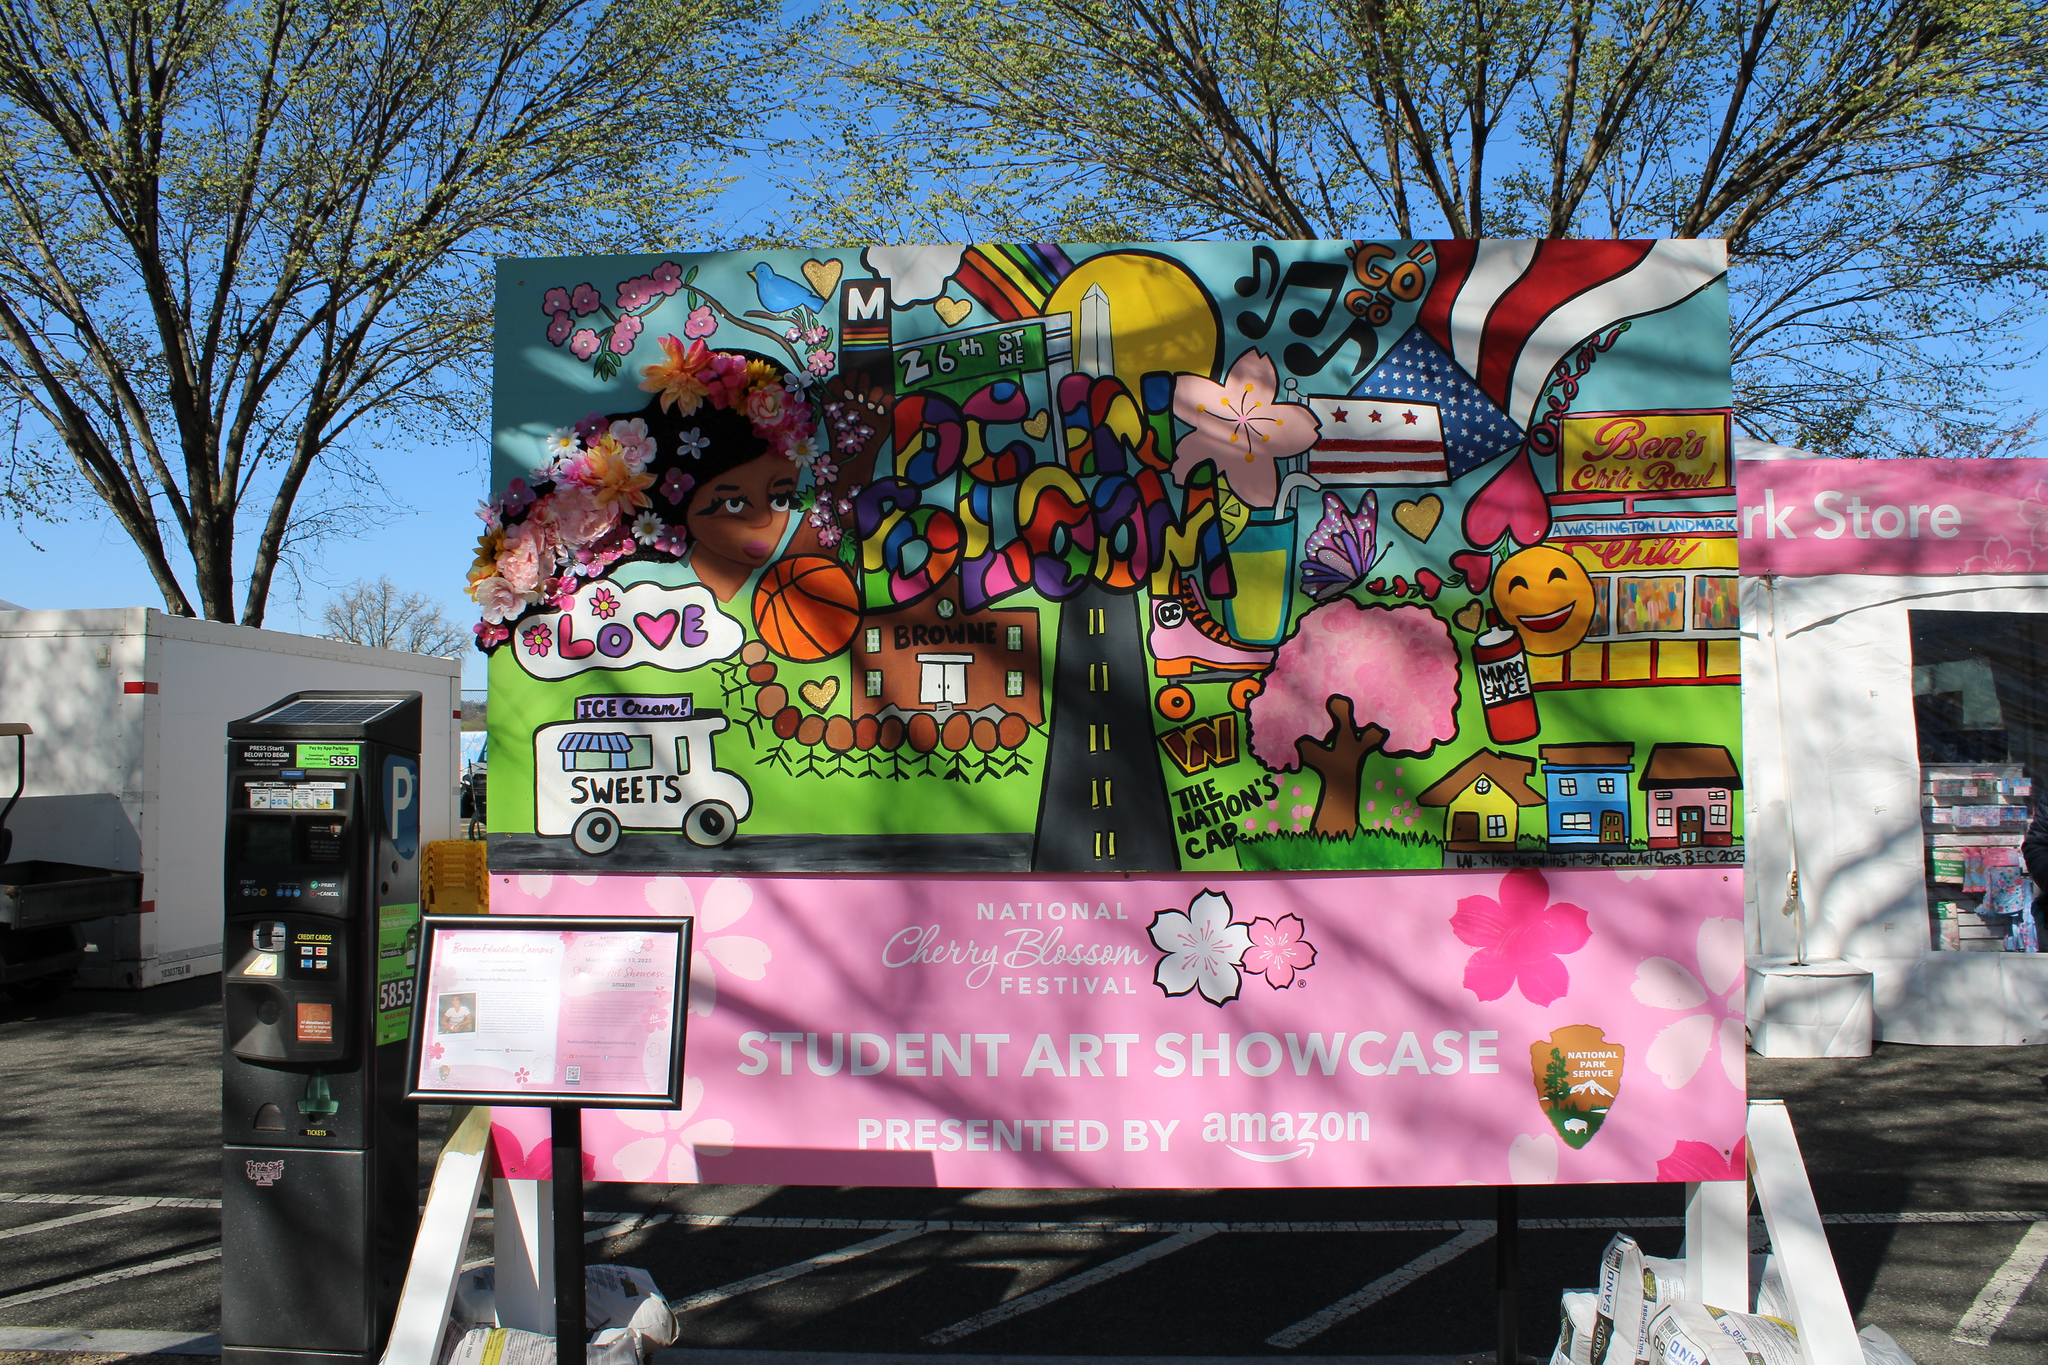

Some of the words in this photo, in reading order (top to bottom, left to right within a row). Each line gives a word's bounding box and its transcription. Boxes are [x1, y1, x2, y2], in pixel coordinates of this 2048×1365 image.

[847, 286, 886, 321] M
[899, 337, 984, 385] 26th
[999, 329, 1025, 352] ST
[999, 351, 1025, 367] NE
[1582, 418, 1707, 463] Ben's
[1571, 463, 1634, 491] Chili
[1637, 460, 1718, 490] Bowl
[1552, 526, 1562, 536] A
[1565, 519, 1655, 536] WASHINGTON
[1658, 518, 1737, 534] LANDMARK
[1814, 489, 1962, 540] Store
[1597, 538, 1702, 569] Chili
[1159, 603, 1182, 623] DC
[893, 621, 998, 651] BROWNE
[1480, 660, 1525, 687] MUMBO
[1484, 677, 1528, 701] SAUCE
[580, 698, 617, 718] ICE
[622, 696, 690, 718] Cream!
[330, 756, 357, 766] 5853
[391, 766, 413, 840] P
[570, 774, 683, 806] SWEETS
[1171, 778, 1223, 812] THE
[1177, 773, 1279, 835] NATION'S
[1513, 853, 1567, 868] Meredith's
[1601, 851, 1636, 868] Grade
[1717, 849, 1746, 865] 2025
[977, 902, 1129, 921] NATIONAL
[452, 942, 480, 954] Browne
[482, 943, 520, 954] Education
[521, 943, 555, 956] Campus
[882, 924, 999, 989] Cherry
[1003, 927, 1149, 969] Blossom
[624, 966, 666, 978] Showcase
[1000, 976, 1138, 995] FESTIVAL
[380, 979, 413, 1005] 5853
[736, 1030, 1010, 1078] STUDENT
[1021, 1032, 1139, 1078] ART
[1153, 1030, 1500, 1078] SHOWCASE
[1567, 1051, 1619, 1060] NATIONAL
[1579, 1060, 1607, 1069] PARK
[1572, 1069, 1614, 1078] SERVICE
[857, 1118, 1110, 1153] PRESENTED
[1123, 1119, 1181, 1153] BY
[1202, 1110, 1370, 1150] amazon
[1602, 1270, 1615, 1314] SAND
